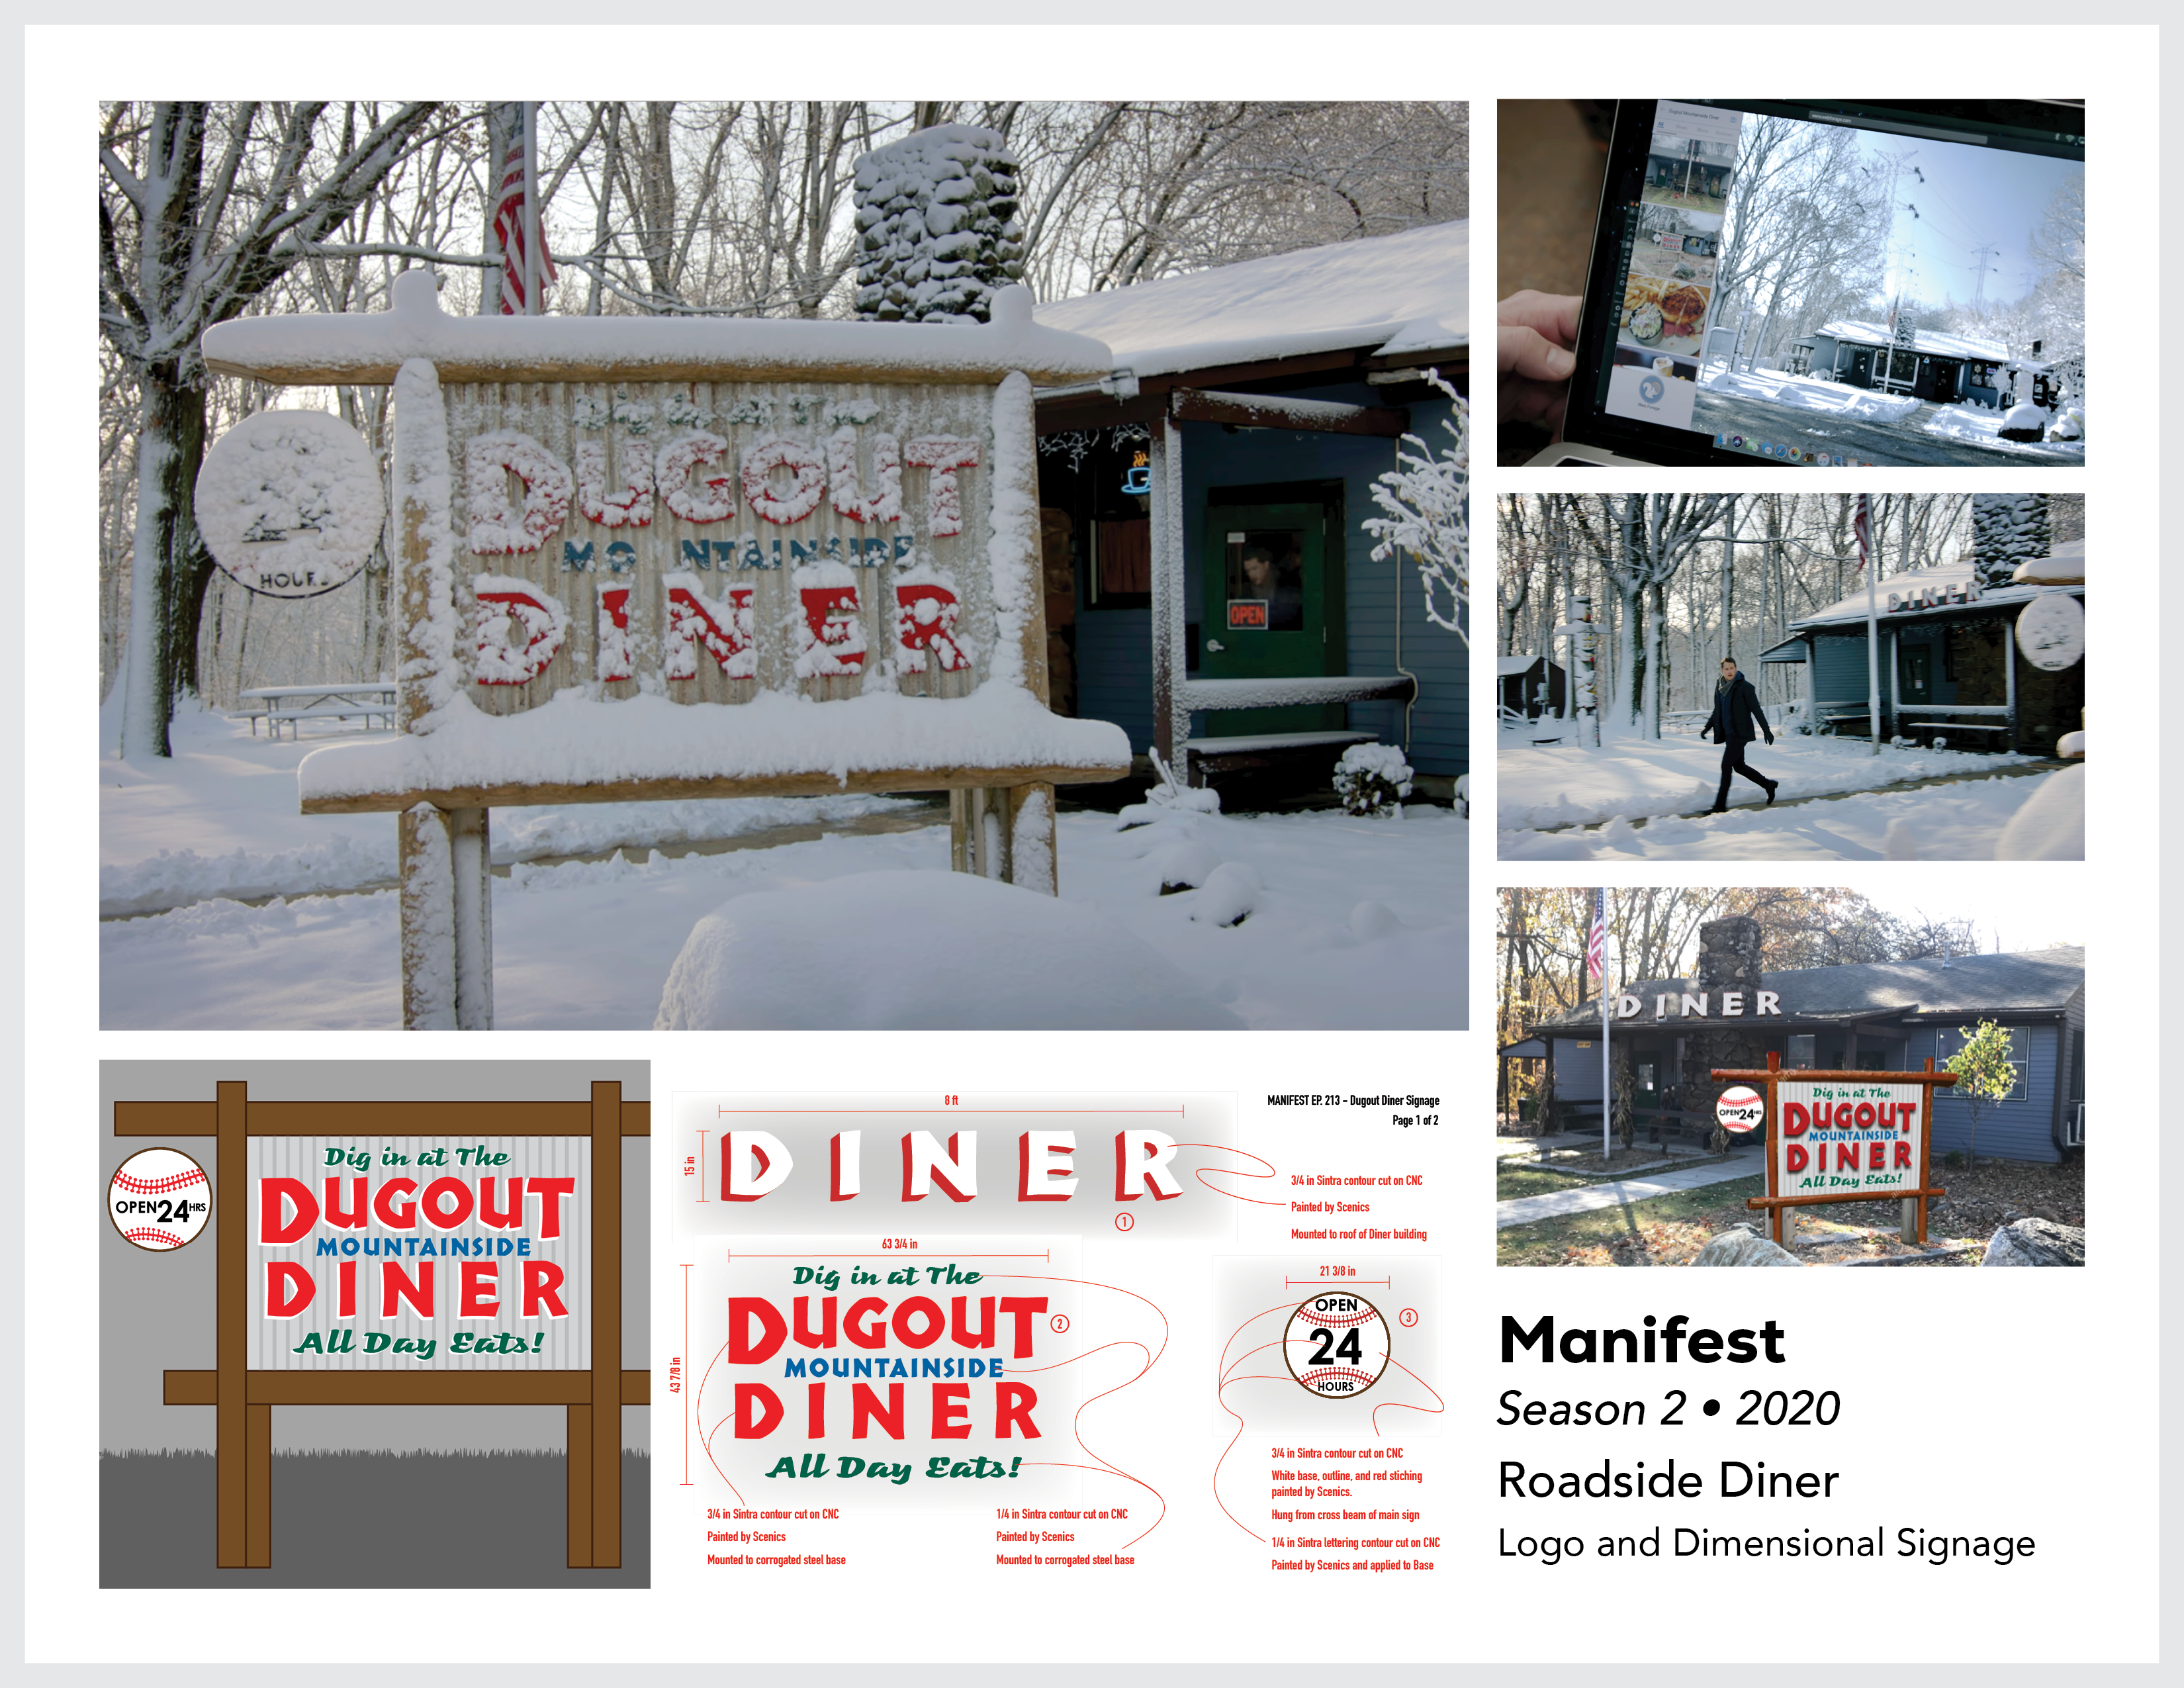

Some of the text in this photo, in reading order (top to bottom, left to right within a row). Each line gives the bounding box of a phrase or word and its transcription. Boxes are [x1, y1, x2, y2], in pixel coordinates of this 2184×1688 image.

[1683, 111, 1709, 119] Mountainside
[466, 428, 981, 555] DUGOUT
[560, 534, 915, 573] MONTAINSIDE
[1888, 581, 1981, 613] DINER
[1230, 605, 1265, 624] OPEN
[474, 583, 972, 686] DINER
[1617, 991, 1782, 1018] DINER
[944, 1094, 959, 1105] 8 ft
[1267, 1094, 1440, 1109] MANIFEST EP. 213 Dugout Diner Signage
[1812, 1088, 1891, 1100] Dig in at The
[1392, 1114, 1439, 1129] Page 1 of 2
[1739, 1109, 1754, 1120] 24
[1783, 1102, 1917, 1136] DUGOUT
[1809, 1131, 1898, 1141] MOUNTAINSIDE
[324, 1145, 512, 1172] Dig in at The
[1787, 1141, 1912, 1171] DINER
[684, 1166, 695, 1176] 15
[721, 1130, 1183, 1202] DINER
[1291, 1174, 1423, 1186] 3/4 in Sintra contour cut on CNC
[1798, 1174, 1903, 1188] All Day Eats!
[115, 1199, 206, 1223] OPEN 24 HRS
[260, 1176, 575, 1243] DUGOUT
[1121, 1217, 1127, 1227] 1
[1291, 1228, 1428, 1243] Mounted to roof of Diner building
[316, 1237, 531, 1257] MOUNTAINSIDE
[882, 1238, 918, 1249] 63 3/4 in
[793, 1263, 983, 1291] Dig in at The
[1320, 1265, 1356, 1276] 21 3/8 in
[265, 1260, 569, 1318] DINER
[1315, 1298, 1358, 1312] OPEN
[1057, 1318, 1063, 1329] 2
[1406, 1313, 1412, 1323] 3
[728, 1296, 1048, 1364] DUGOUT
[293, 1329, 545, 1360] All Day Eats!
[1308, 1327, 1363, 1366] 24
[669, 1357, 681, 1393] 43 7/8 in
[784, 1357, 1004, 1378] MOUNTAINSIDE
[1317, 1382, 1354, 1392] HOURS
[734, 1382, 1042, 1440] DINER
[764, 1453, 1023, 1485] All Day Eats!
[1271, 1470, 1423, 1484] White base, outline, and red stiching
[1271, 1485, 1353, 1500] painted by Scenics.
[707, 1508, 839, 1519] 3/4 in Sintra contour cut on CNC
[1271, 1509, 1420, 1523] Hung from cross beam of main sign
[707, 1530, 786, 1544] Painted by Scenics
[1271, 1536, 1441, 1551] 1/4 in Sintra lettering contour cut on CNC
[707, 1554, 846, 1568] Mounted to corrogated steel base
[1271, 1559, 1434, 1573] Painted by Scenics and applied to Base
